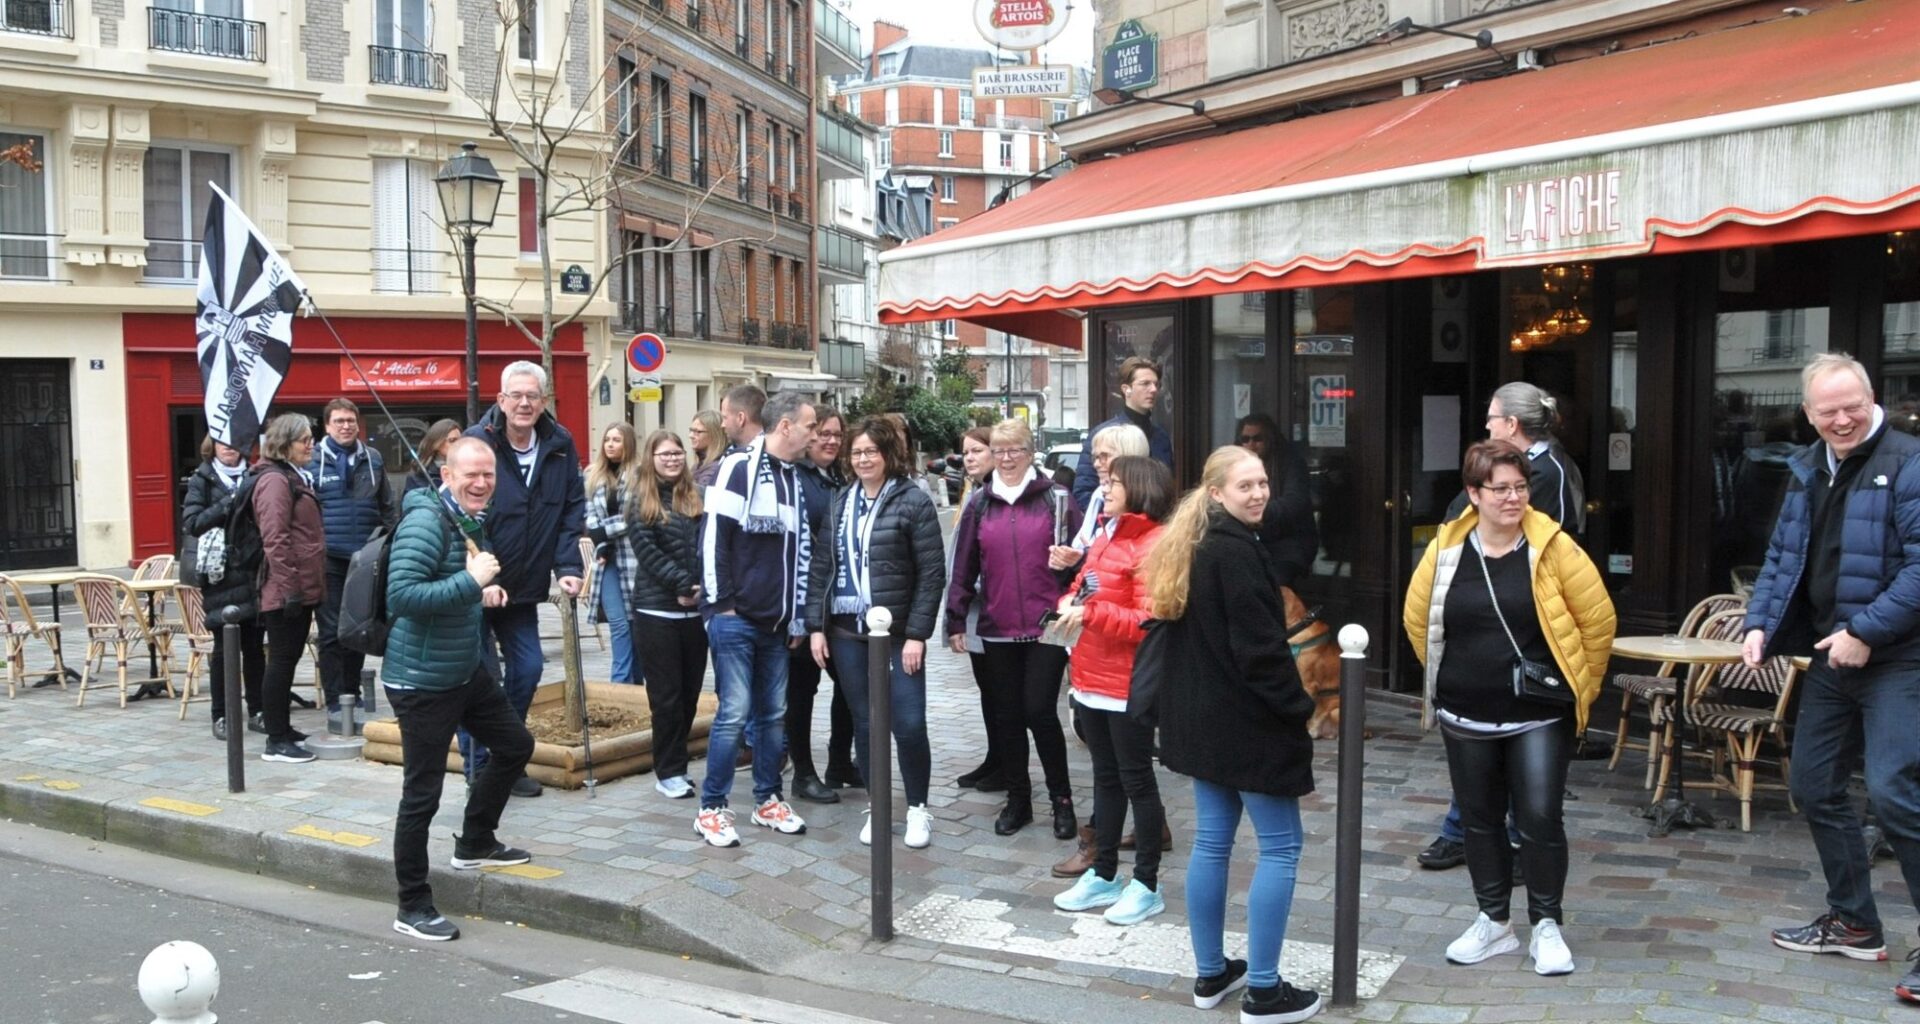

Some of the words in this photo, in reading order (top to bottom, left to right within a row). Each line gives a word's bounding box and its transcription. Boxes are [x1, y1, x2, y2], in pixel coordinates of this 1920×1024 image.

[999, 1, 1043, 12] STELLA
[1000, 10, 1044, 22] ARTOIS
[1117, 44, 1140, 59] PLACE
[979, 74, 1002, 84] BAR
[1004, 71, 1067, 83] BRASSERIE
[984, 84, 1061, 95] RESTAURANT
[94, 360, 100, 369] 2
[425, 361, 438, 375] 16
